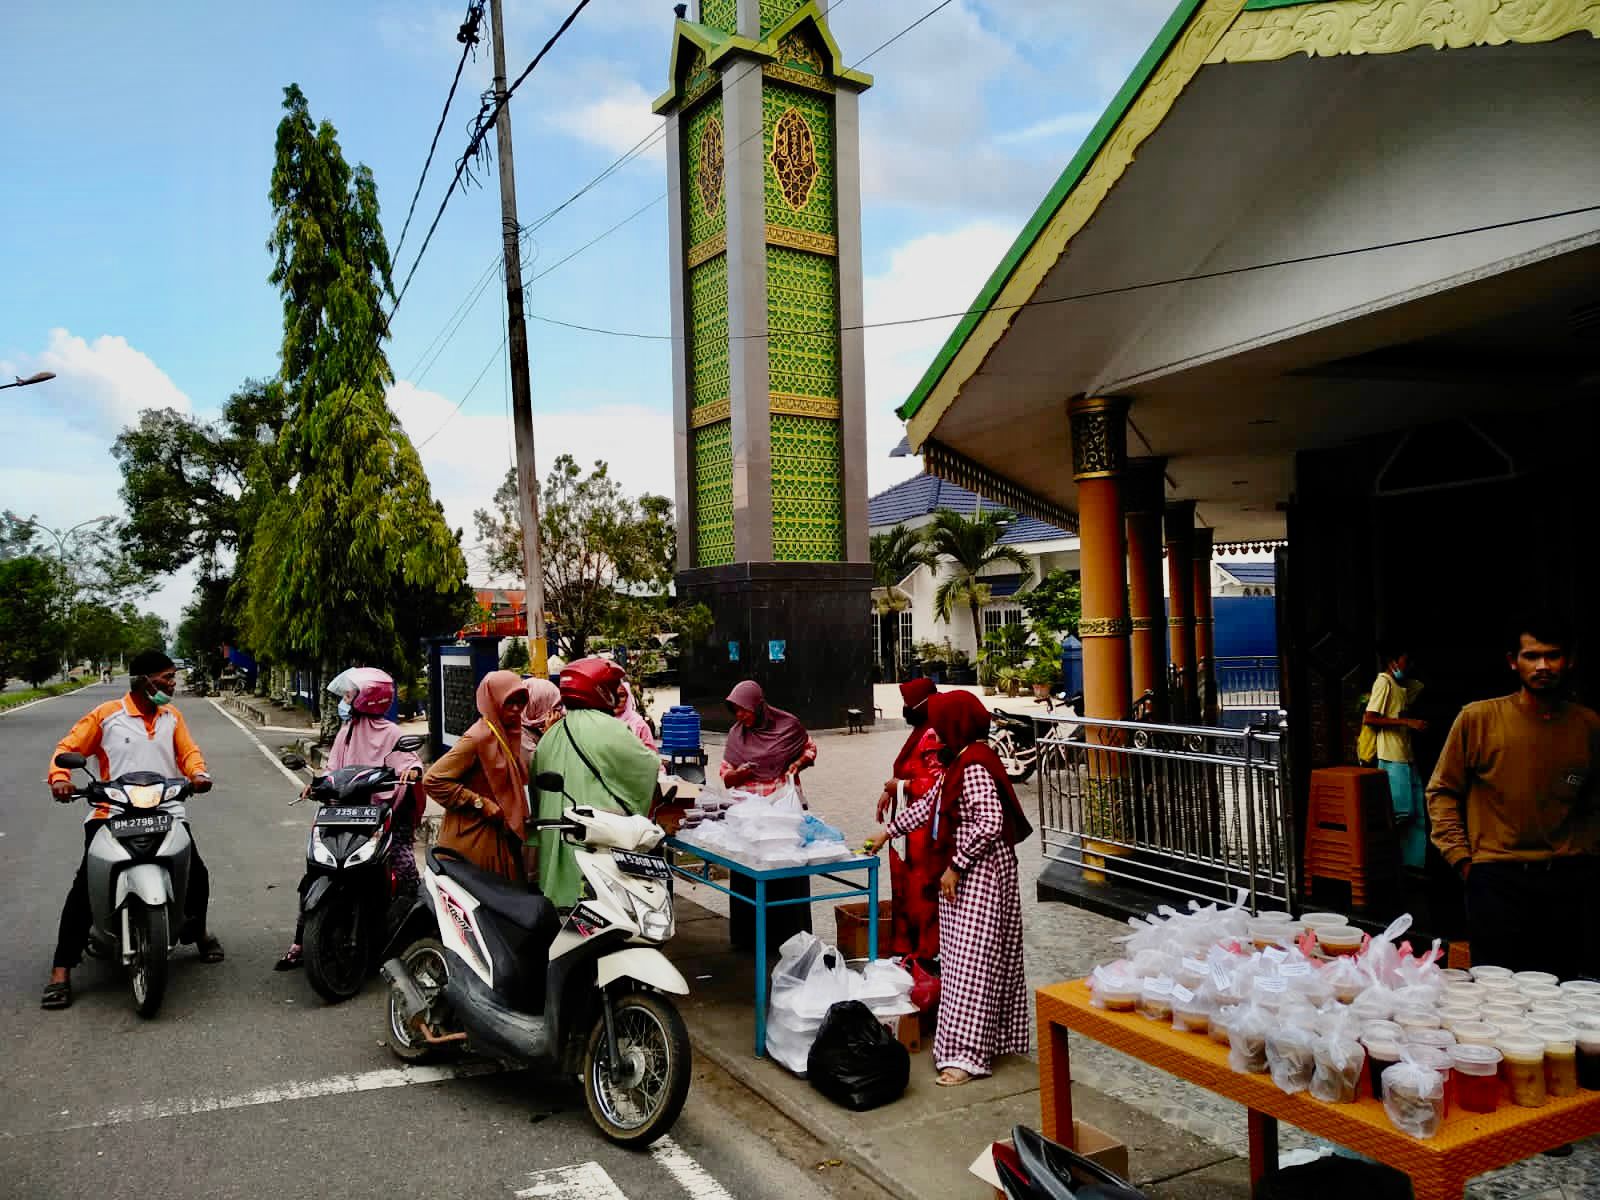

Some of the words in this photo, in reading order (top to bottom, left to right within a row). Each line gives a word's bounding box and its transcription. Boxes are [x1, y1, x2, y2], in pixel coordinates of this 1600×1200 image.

[114, 820, 128, 829] BM
[130, 817, 154, 827] 2796
[157, 816, 168, 824] TJ
[580, 907, 604, 927] HONDA
